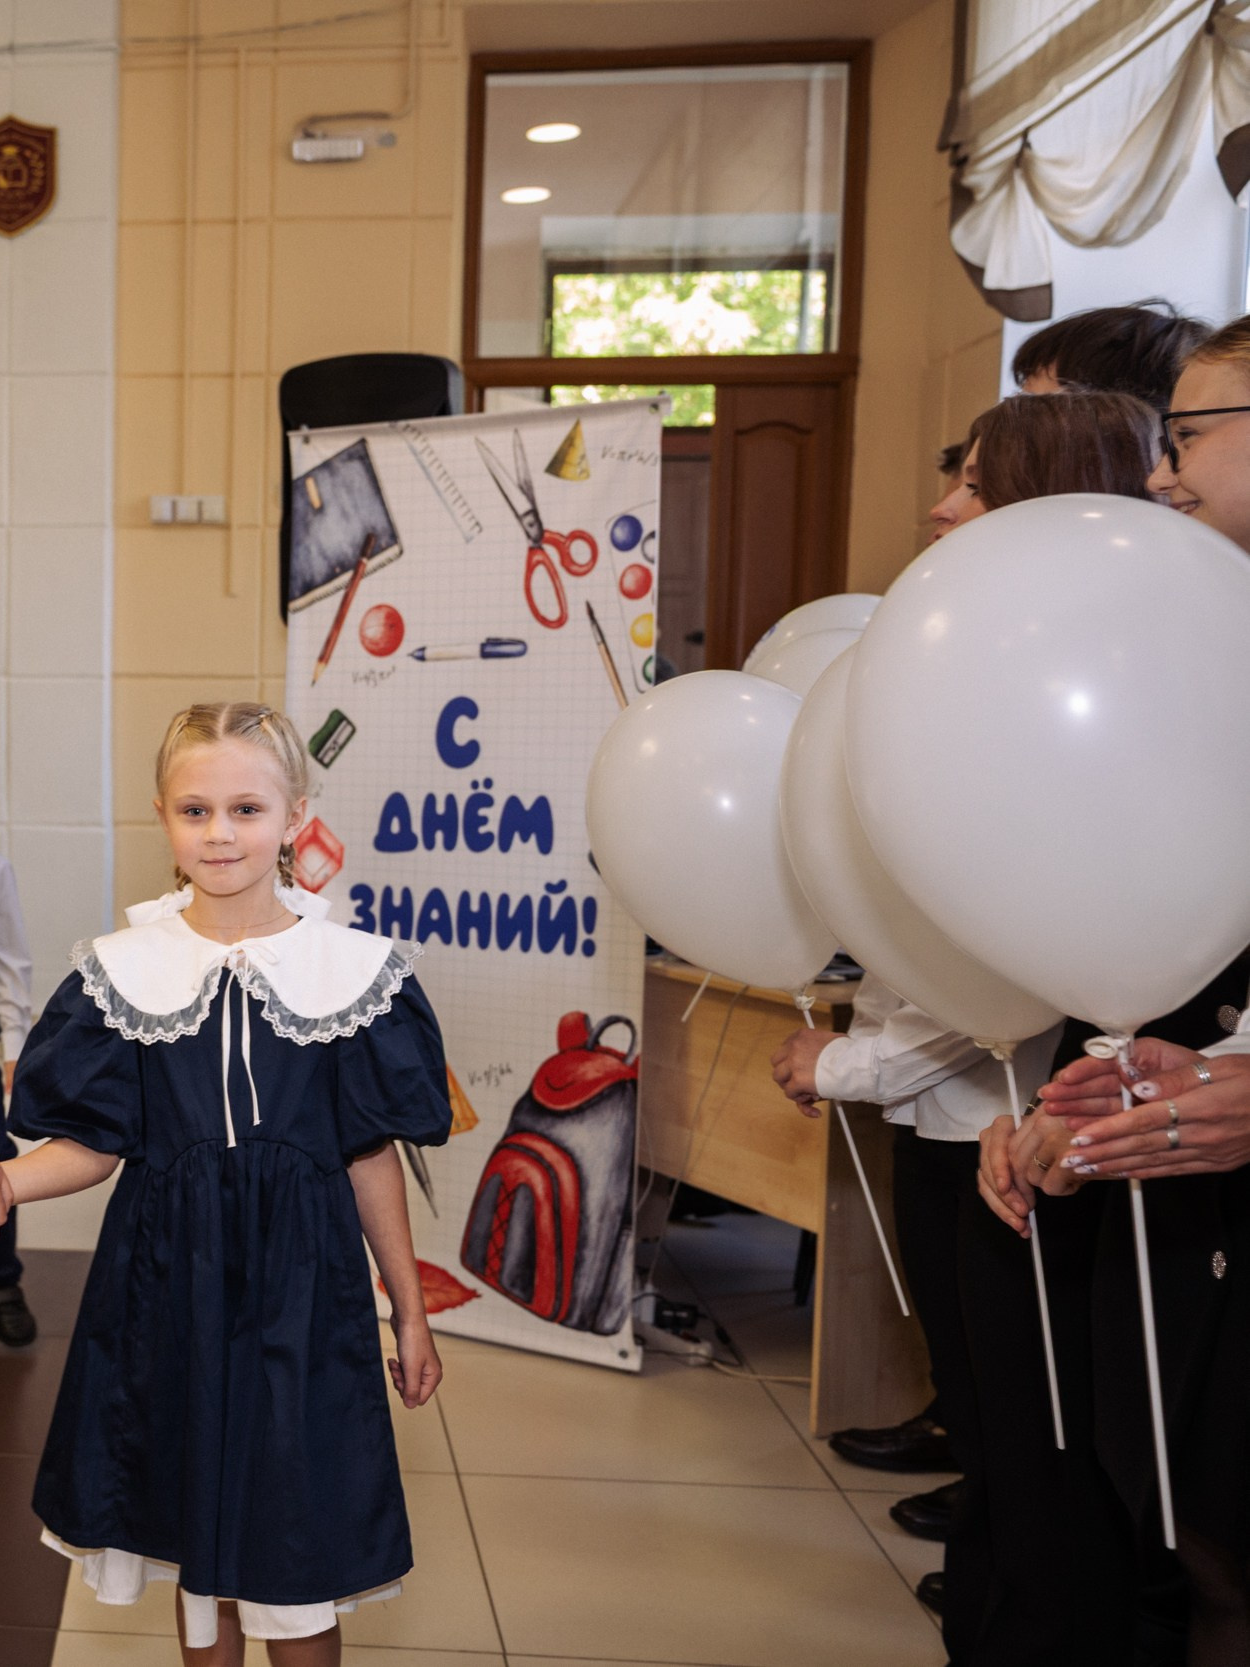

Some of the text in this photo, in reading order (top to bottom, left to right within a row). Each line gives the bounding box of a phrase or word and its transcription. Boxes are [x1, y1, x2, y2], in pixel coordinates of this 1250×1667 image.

[435, 696, 481, 769] С
[373, 777, 554, 855] ДНЁМ
[349, 879, 597, 957] ЗНАНИЙ!
